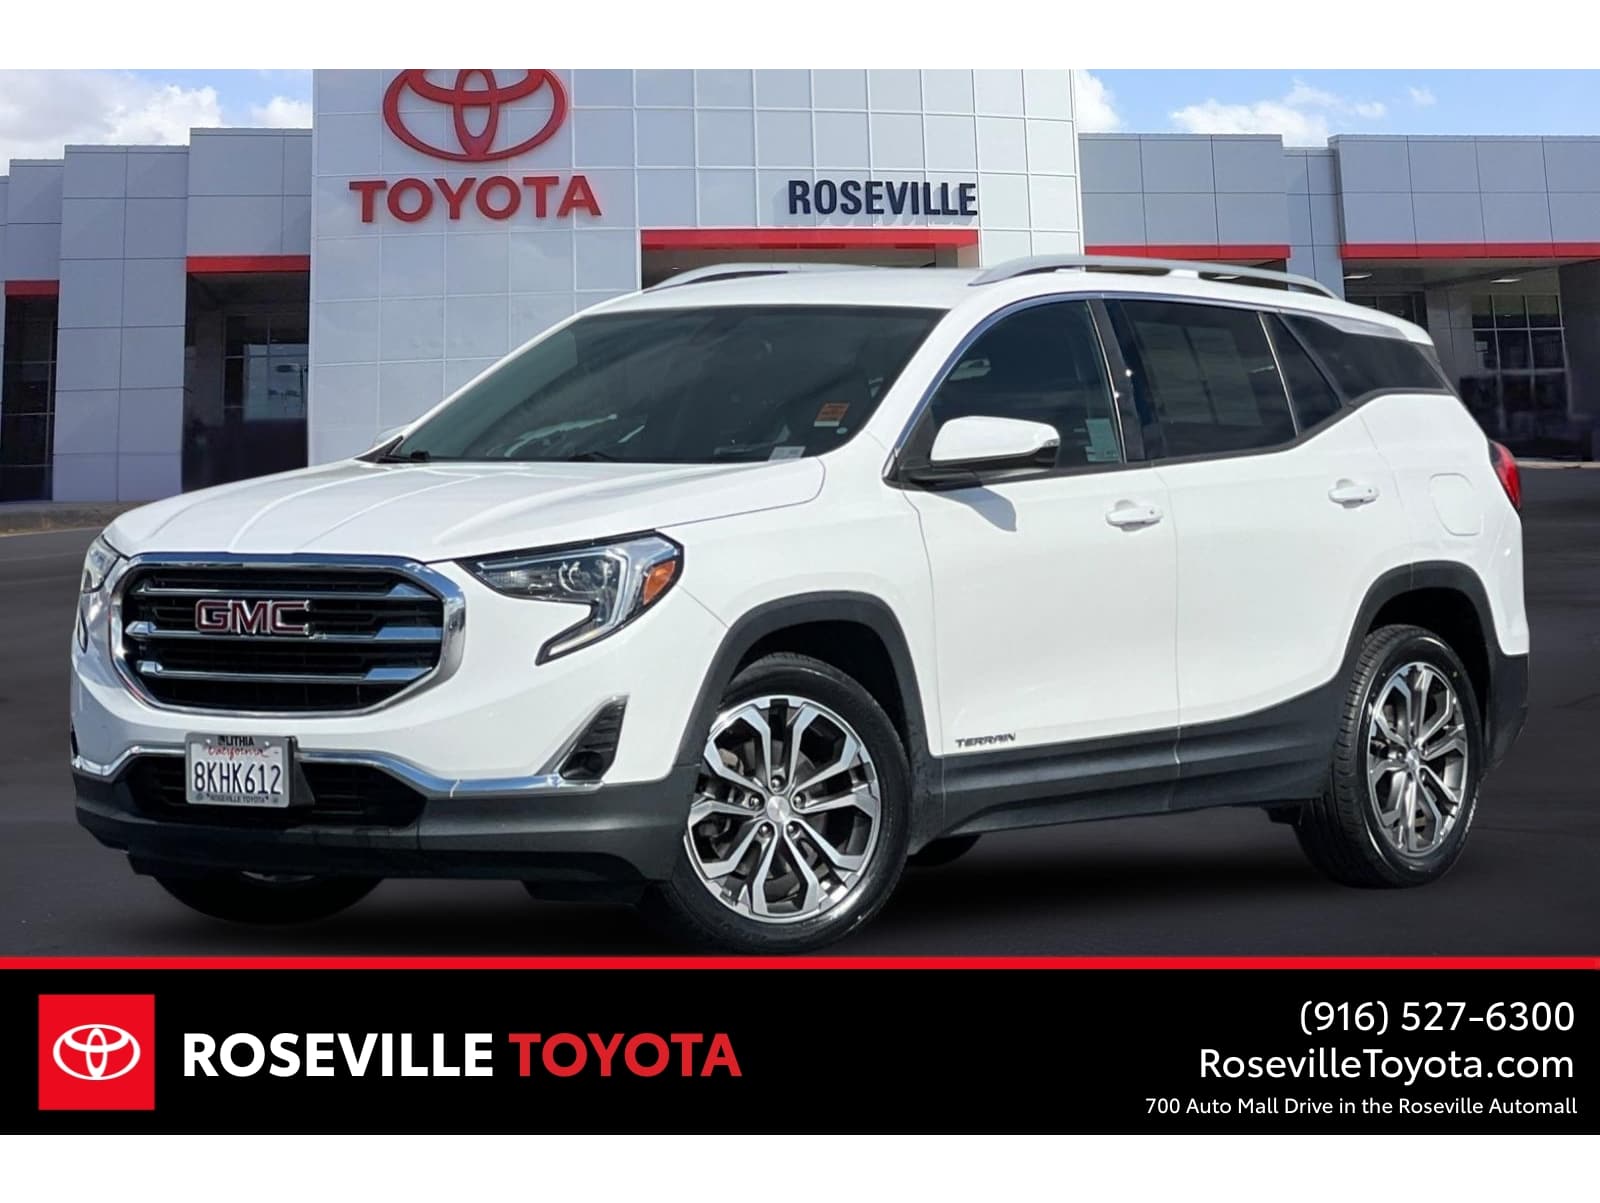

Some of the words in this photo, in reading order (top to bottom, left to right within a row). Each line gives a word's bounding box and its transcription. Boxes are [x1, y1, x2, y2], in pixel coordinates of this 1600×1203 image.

[349, 175, 602, 223] TOYOTA
[788, 179, 978, 216] ROSEVILLE
[195, 599, 310, 635] GMC
[955, 732, 1016, 748] TERRAIN
[194, 761, 282, 795] 8KHK612
